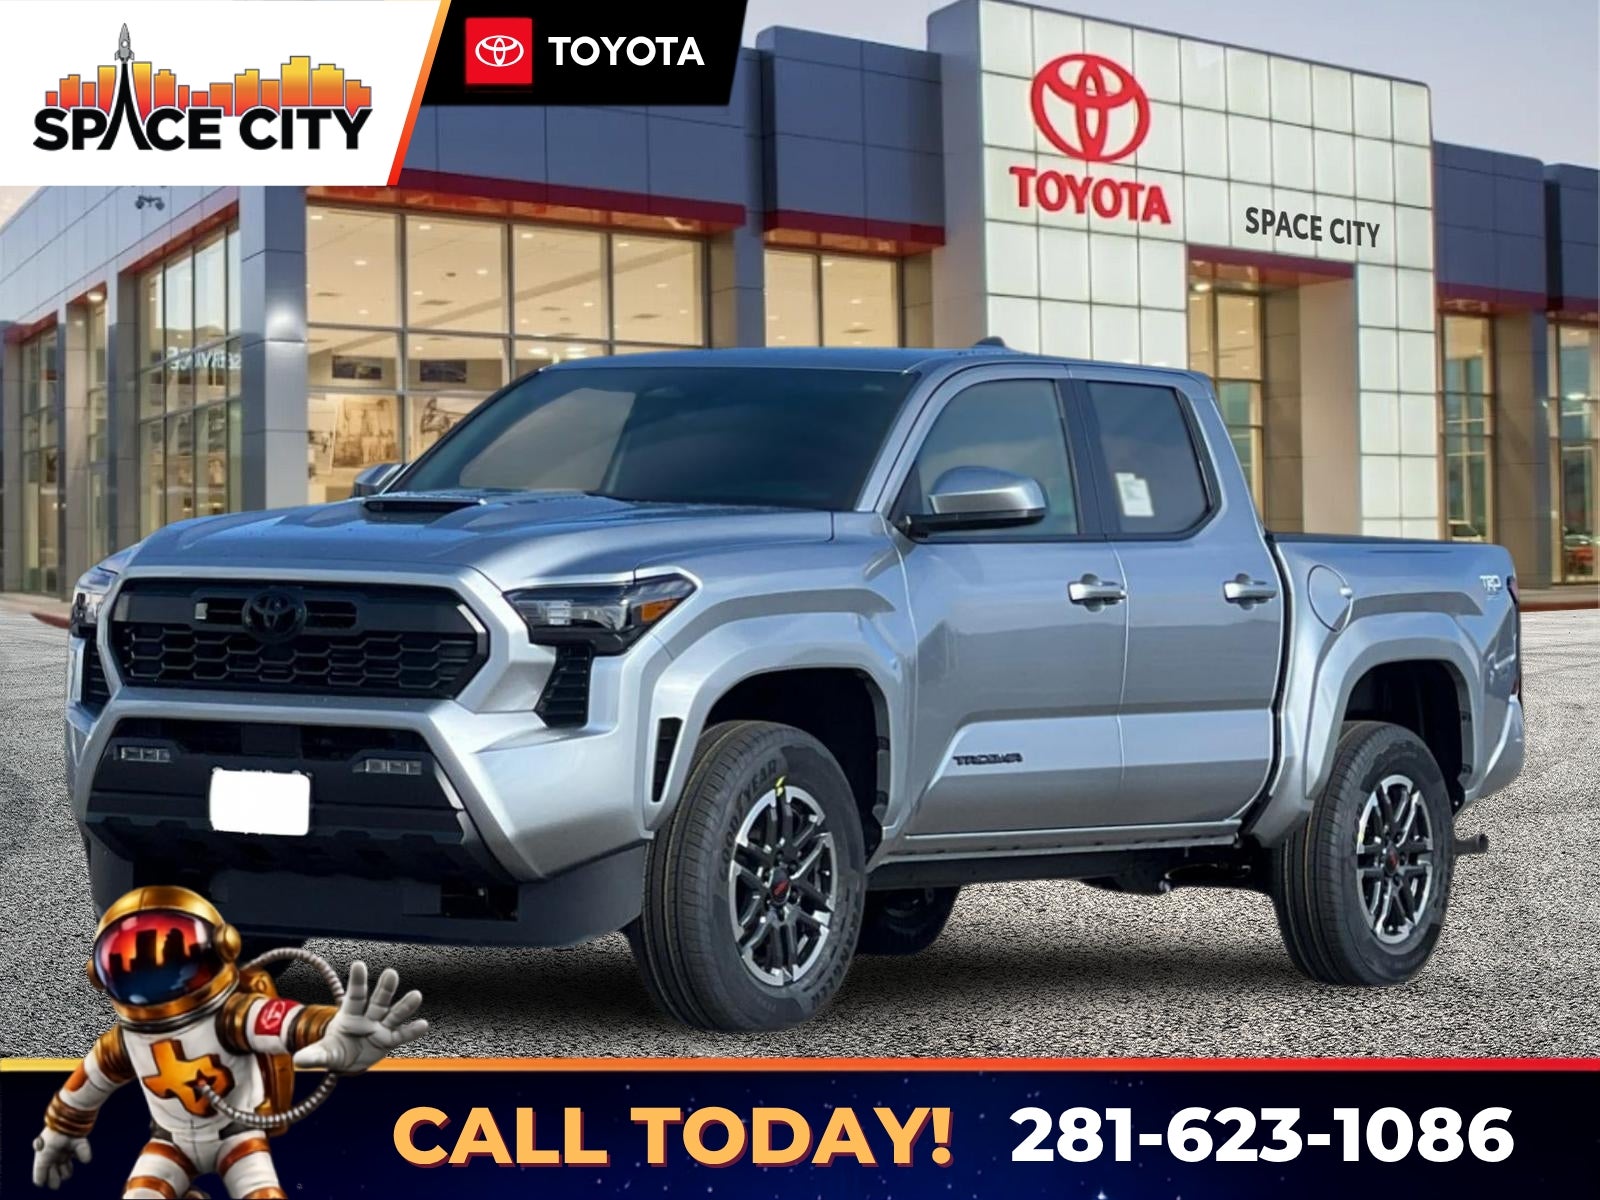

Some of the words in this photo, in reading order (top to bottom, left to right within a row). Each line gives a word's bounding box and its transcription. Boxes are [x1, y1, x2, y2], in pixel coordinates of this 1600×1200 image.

[1009, 166, 1171, 224] TOYOTA
[1245, 206, 1323, 241] SPACE
[1329, 218, 1381, 248] CITY
